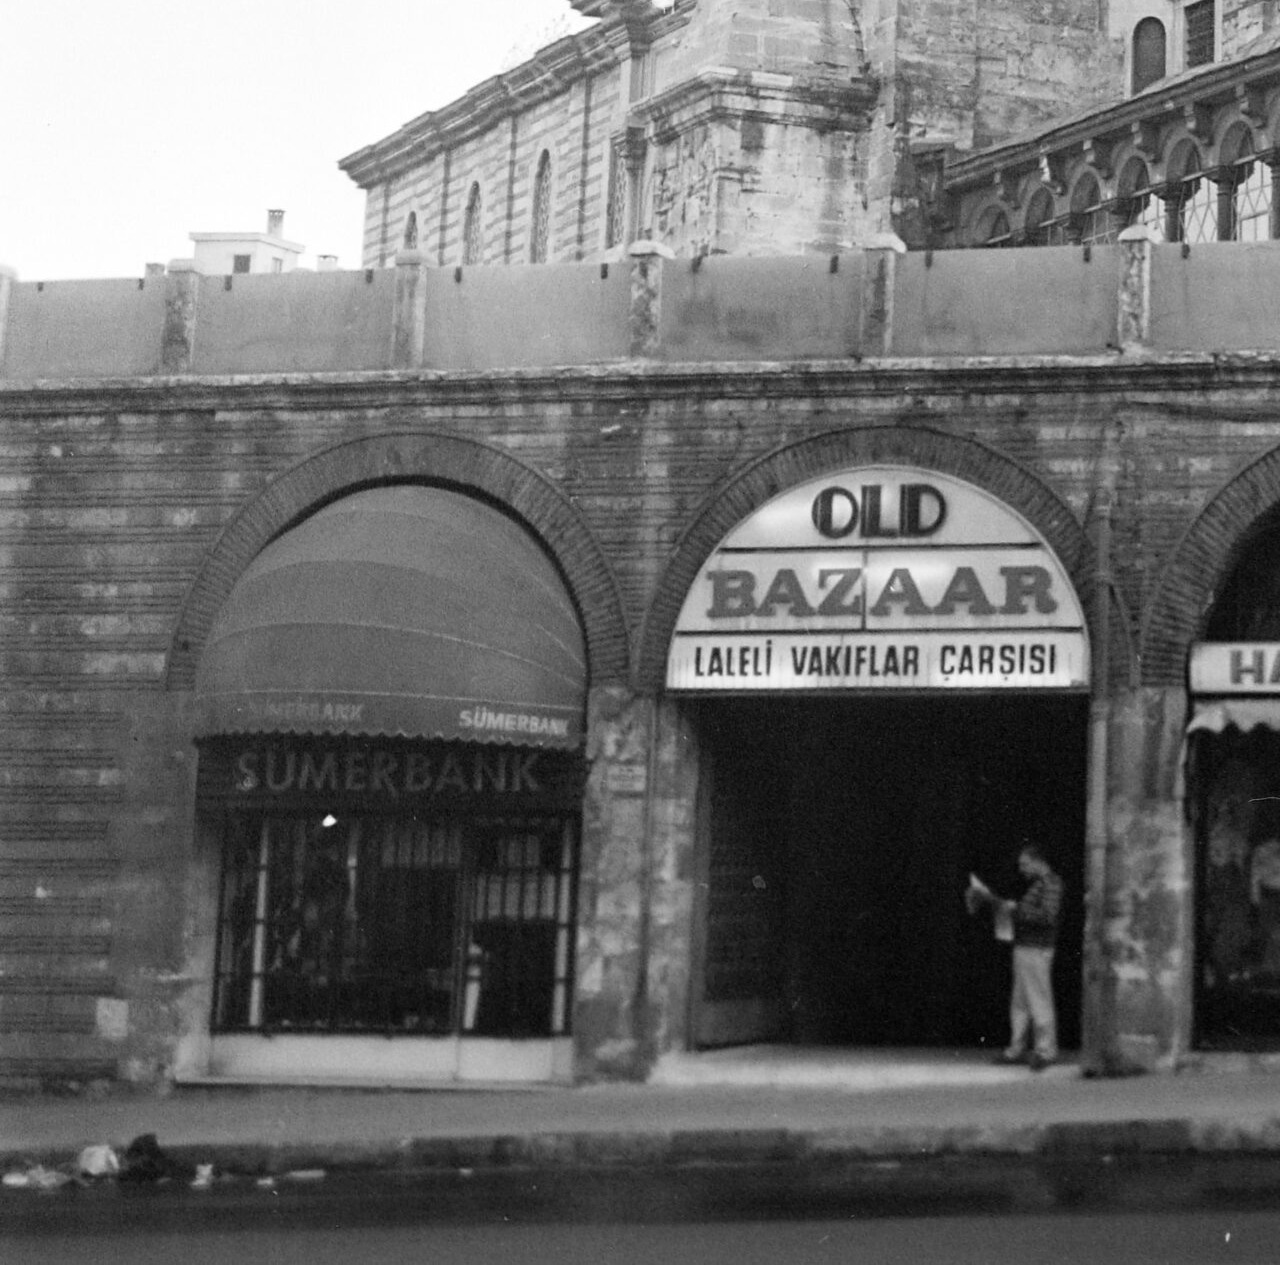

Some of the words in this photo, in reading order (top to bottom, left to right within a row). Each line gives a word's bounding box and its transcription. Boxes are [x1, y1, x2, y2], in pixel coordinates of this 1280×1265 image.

[811, 483, 947, 539] OLD
[706, 565, 1058, 618] BAZAAR
[695, 639, 772, 677] LALELİ
[791, 645, 920, 677] VAKIFLAR
[940, 644, 1056, 680] ÇARŞISI
[458, 705, 569, 737] SÜMERBANK
